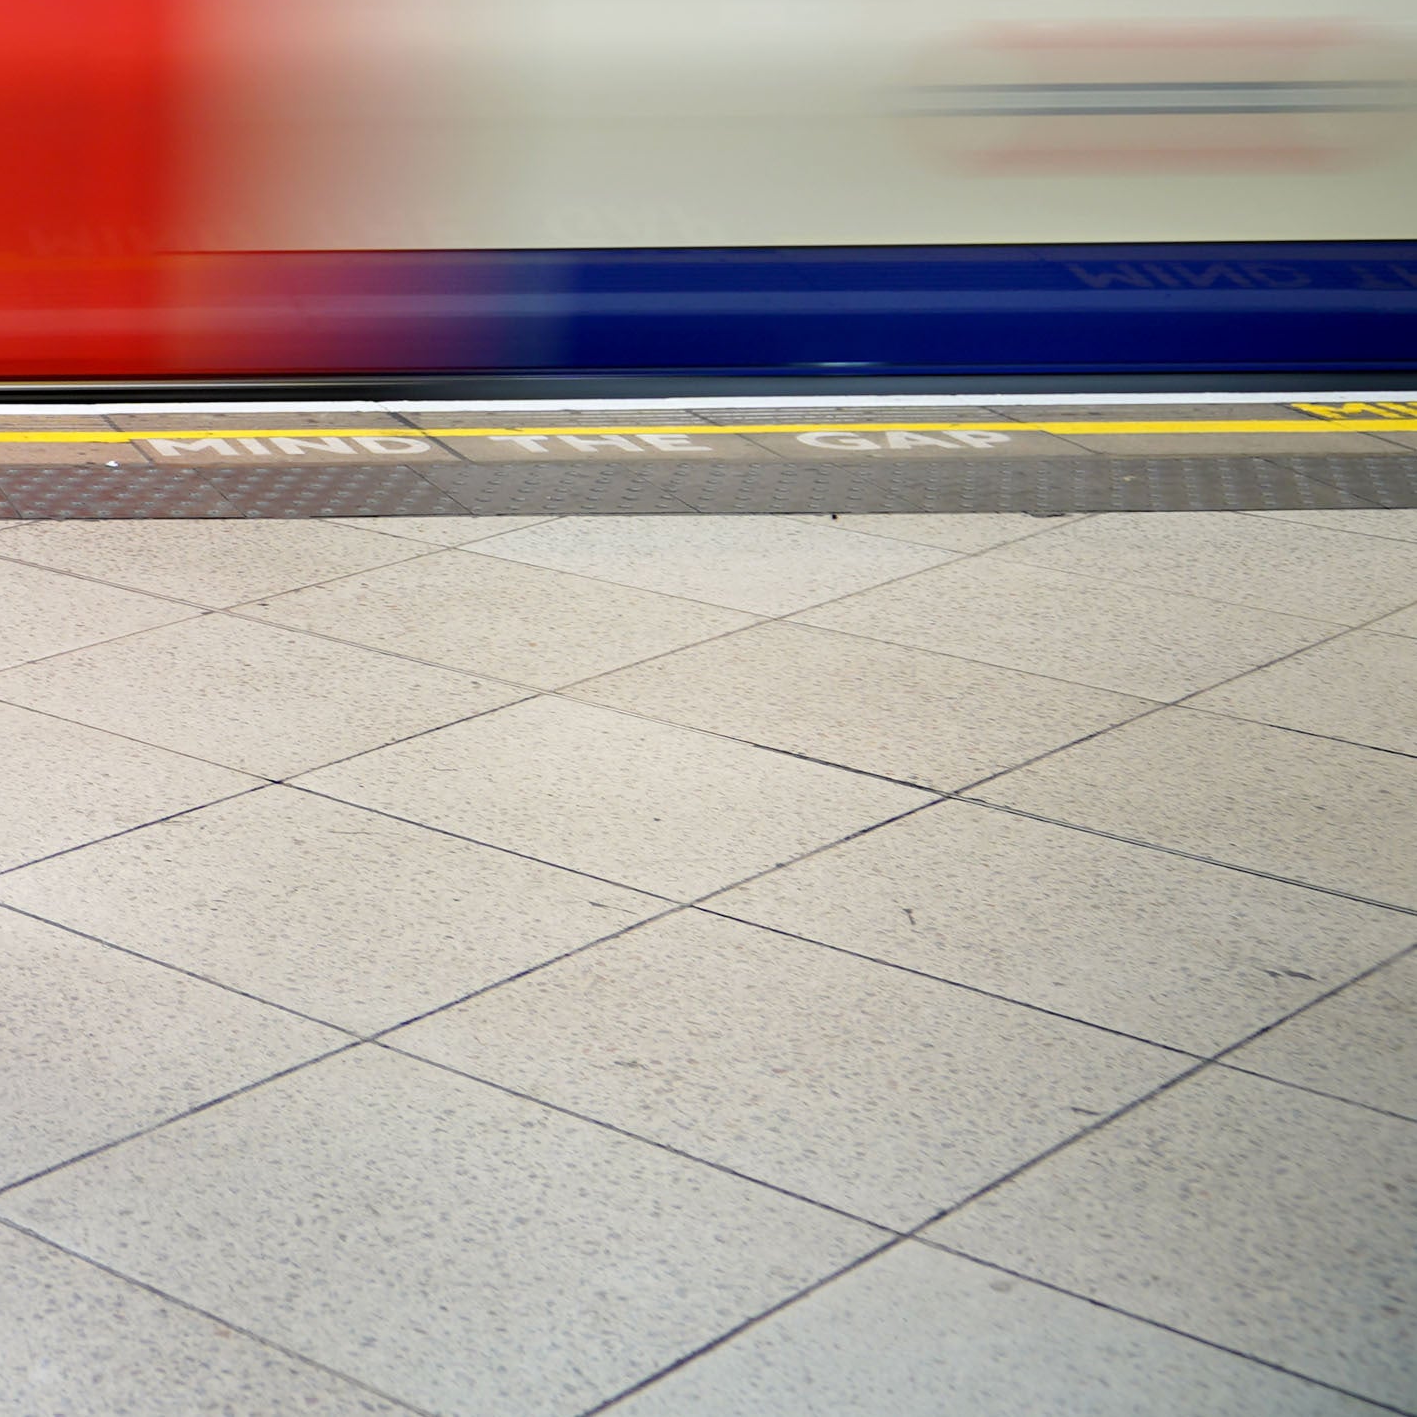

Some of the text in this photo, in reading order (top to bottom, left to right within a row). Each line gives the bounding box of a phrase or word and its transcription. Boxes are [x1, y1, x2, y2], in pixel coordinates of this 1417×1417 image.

[146, 430, 1012, 457] MIND THE GAP
